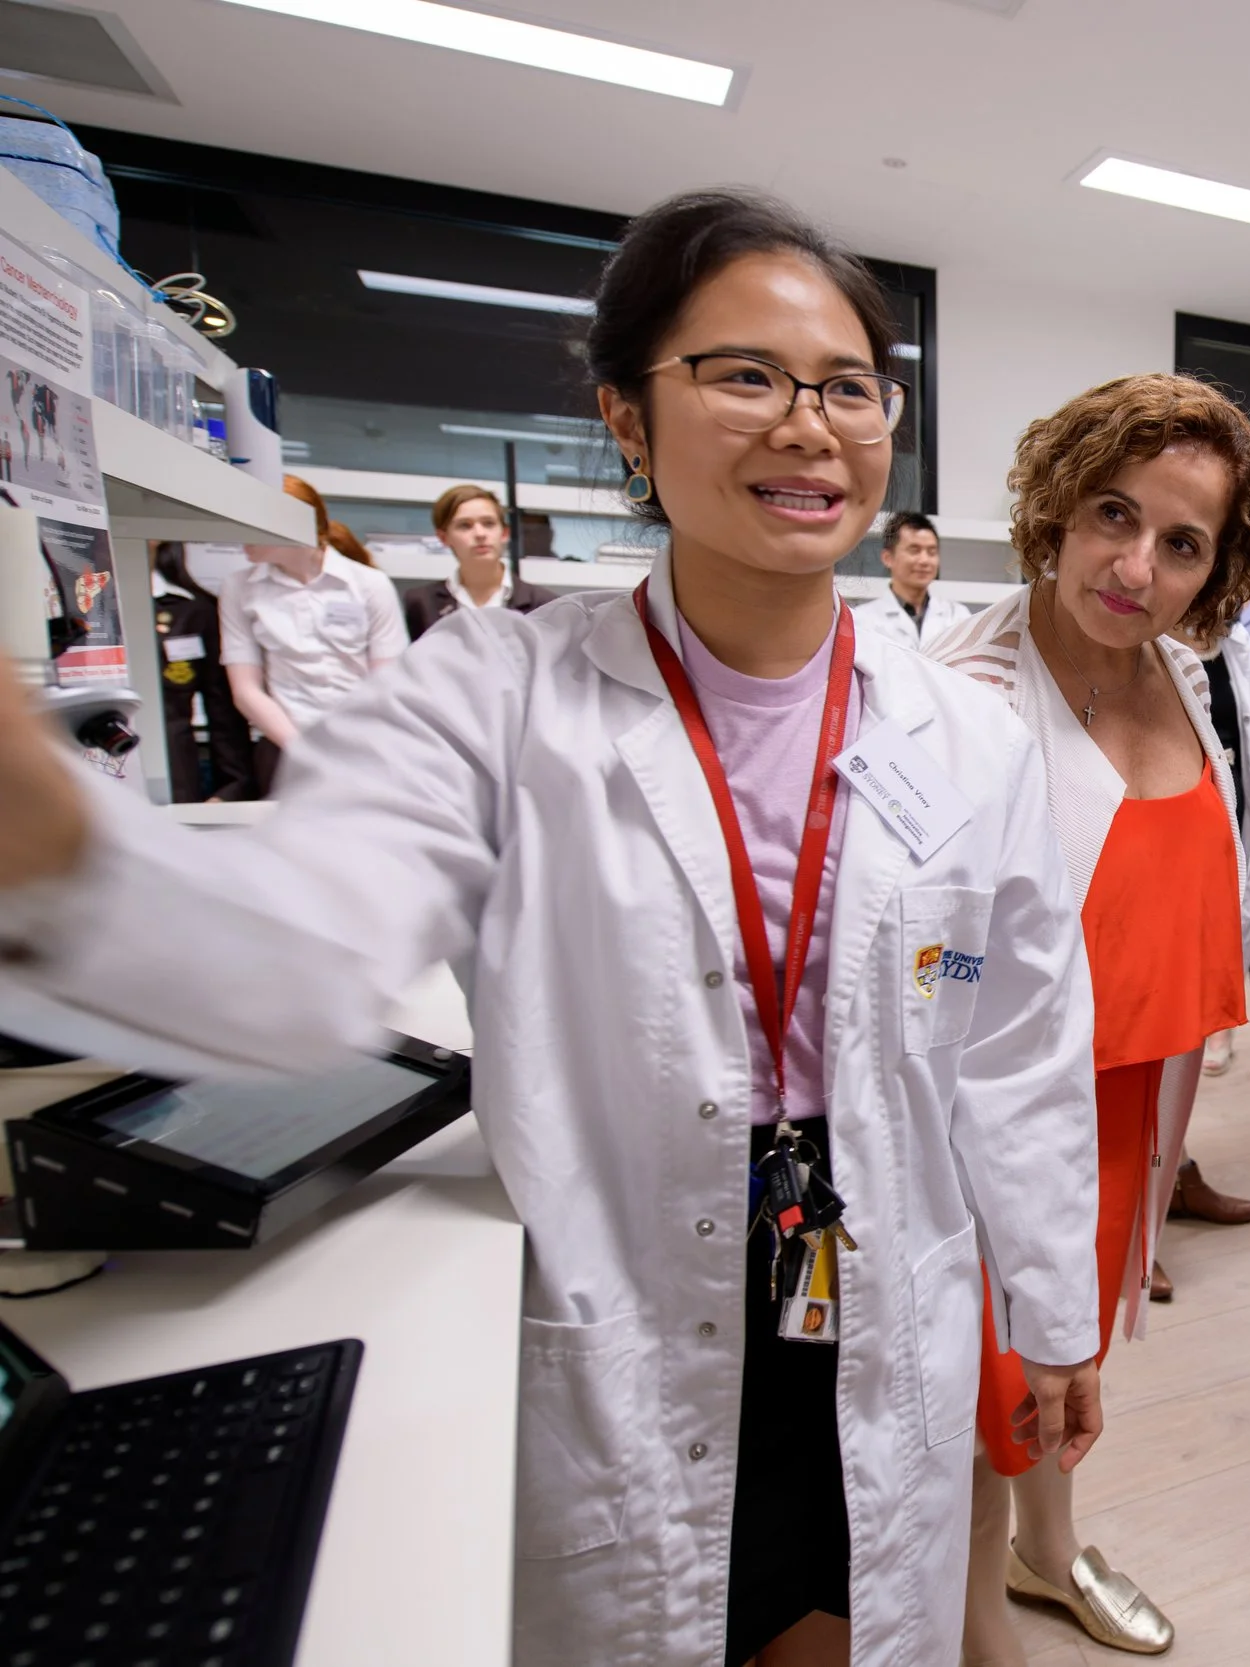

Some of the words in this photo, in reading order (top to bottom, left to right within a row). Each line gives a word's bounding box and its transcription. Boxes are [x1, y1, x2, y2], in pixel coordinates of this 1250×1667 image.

[888, 761, 915, 791] Christina
[915, 789, 931, 809] Viray
[940, 959, 982, 983] YDN
